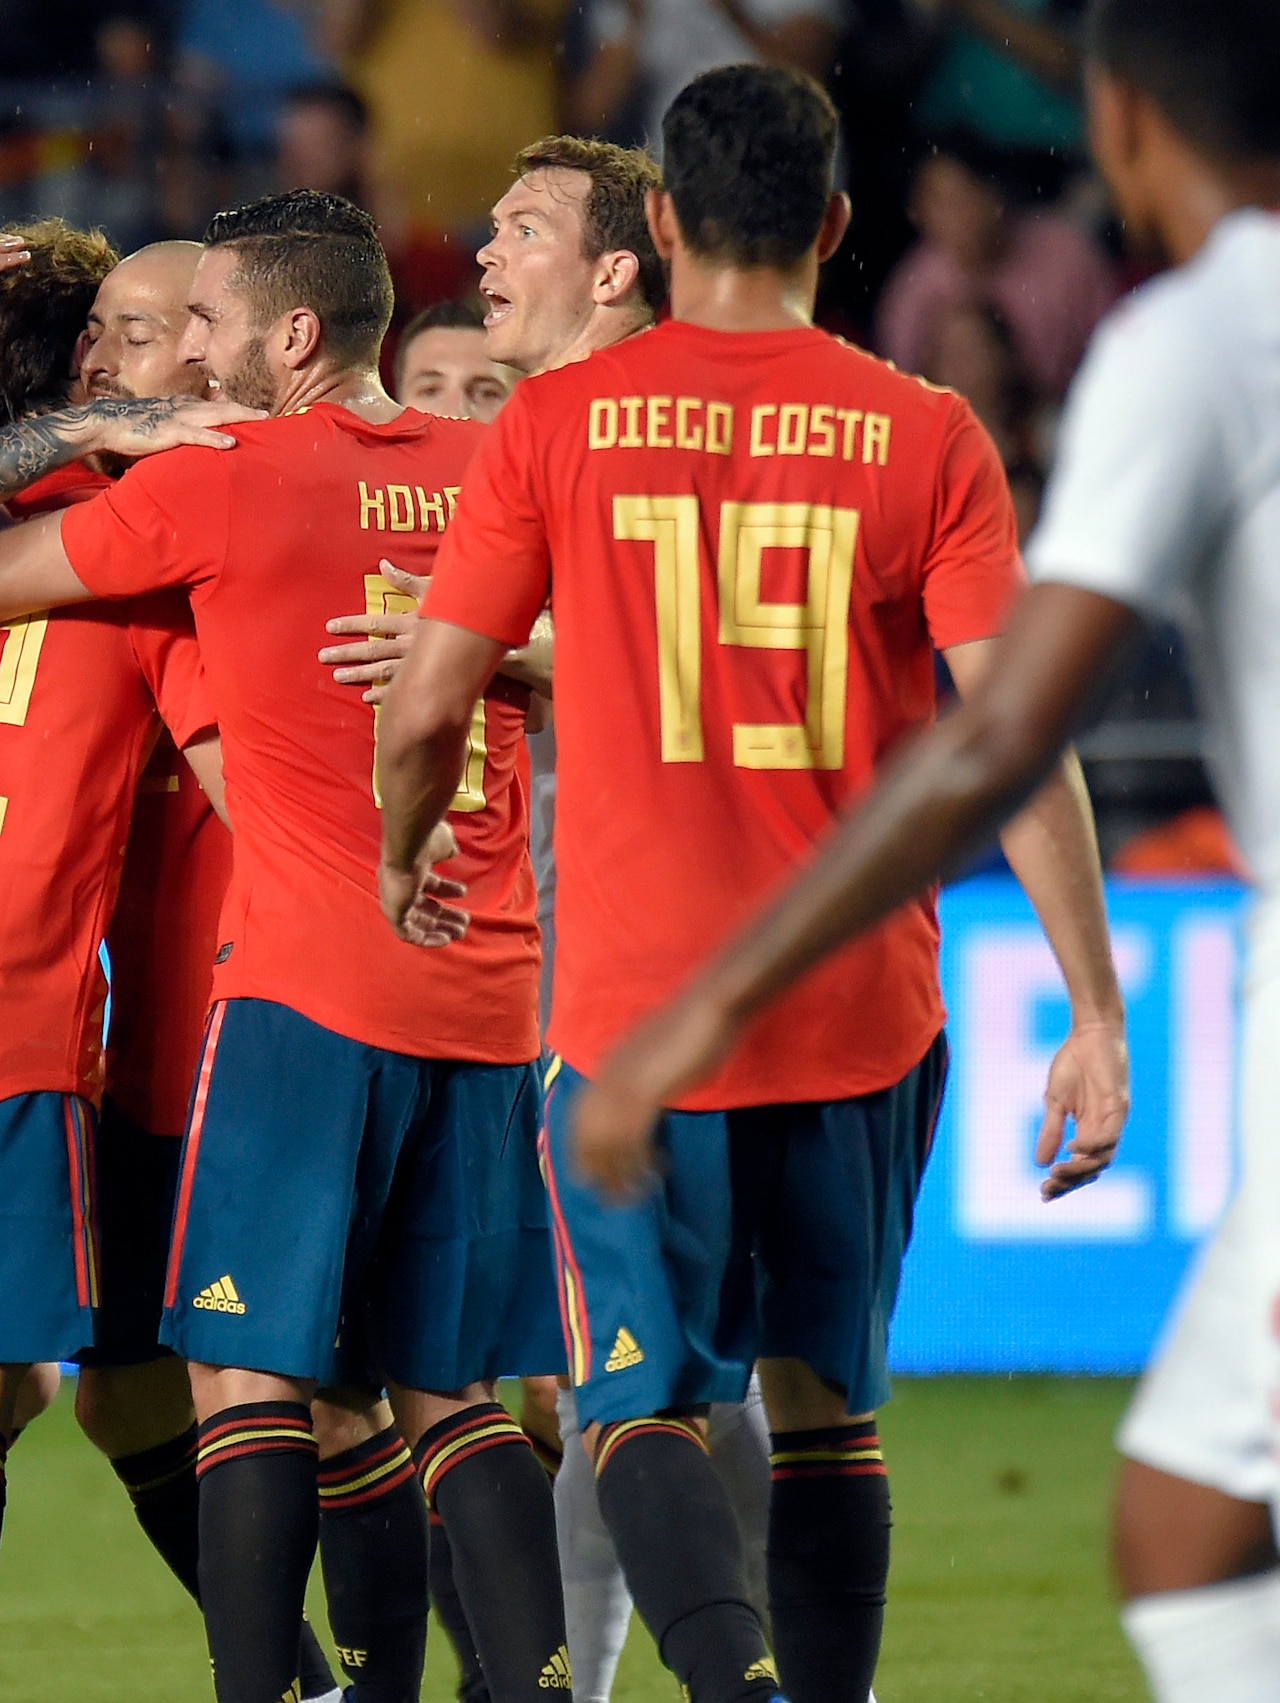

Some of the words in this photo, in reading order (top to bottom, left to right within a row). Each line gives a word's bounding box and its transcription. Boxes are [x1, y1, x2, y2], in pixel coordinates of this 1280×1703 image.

[589, 395, 734, 456] DIEGO
[750, 403, 892, 466] COSTA
[613, 494, 860, 771] 19
[192, 1297, 246, 1315] adidas
